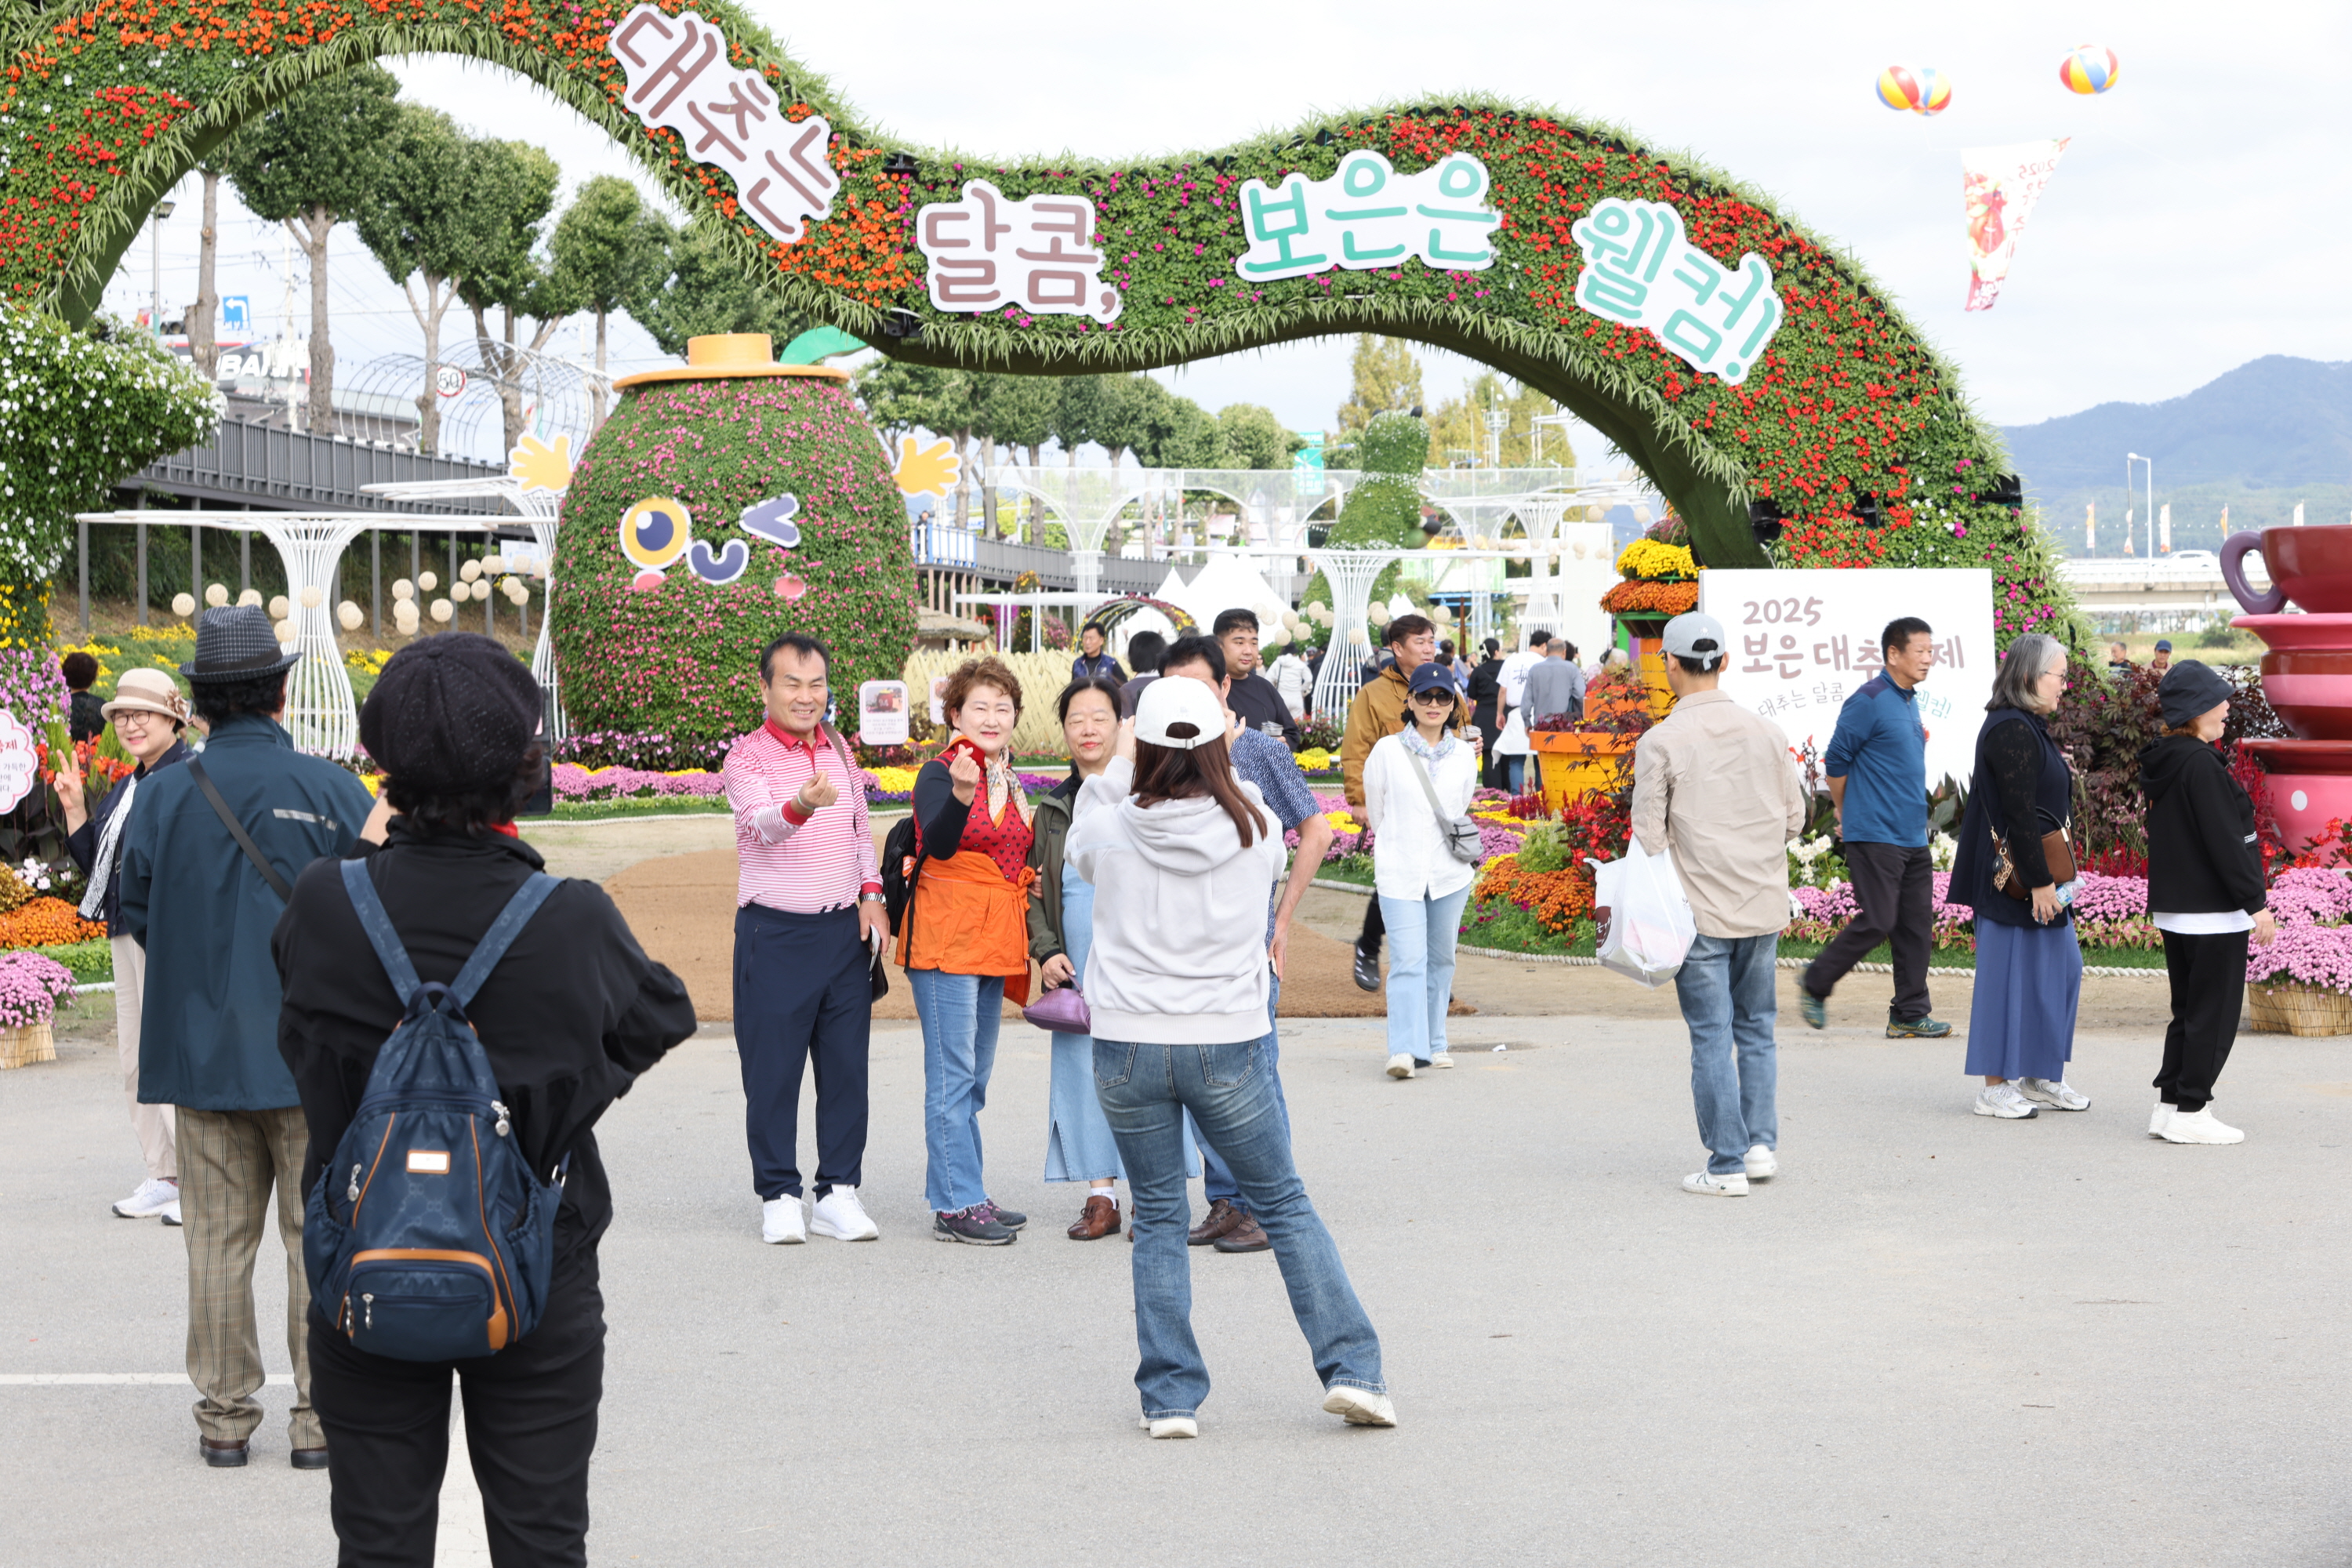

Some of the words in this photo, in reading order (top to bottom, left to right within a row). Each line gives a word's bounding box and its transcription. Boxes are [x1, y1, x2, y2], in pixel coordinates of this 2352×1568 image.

[616, 11, 833, 235] 대추는
[926, 187, 1117, 314] 달콤,
[1244, 158, 1497, 273] 보은은
[1581, 205, 1775, 377] 웰컴!
[439, 372, 459, 388] 50
[1743, 596, 1823, 626] 2025
[1742, 633, 1804, 679] 보은
[1813, 634, 1965, 681] 대추제
[1758, 689, 1806, 717] 대추는
[3, 763, 26, 771] 가득한
